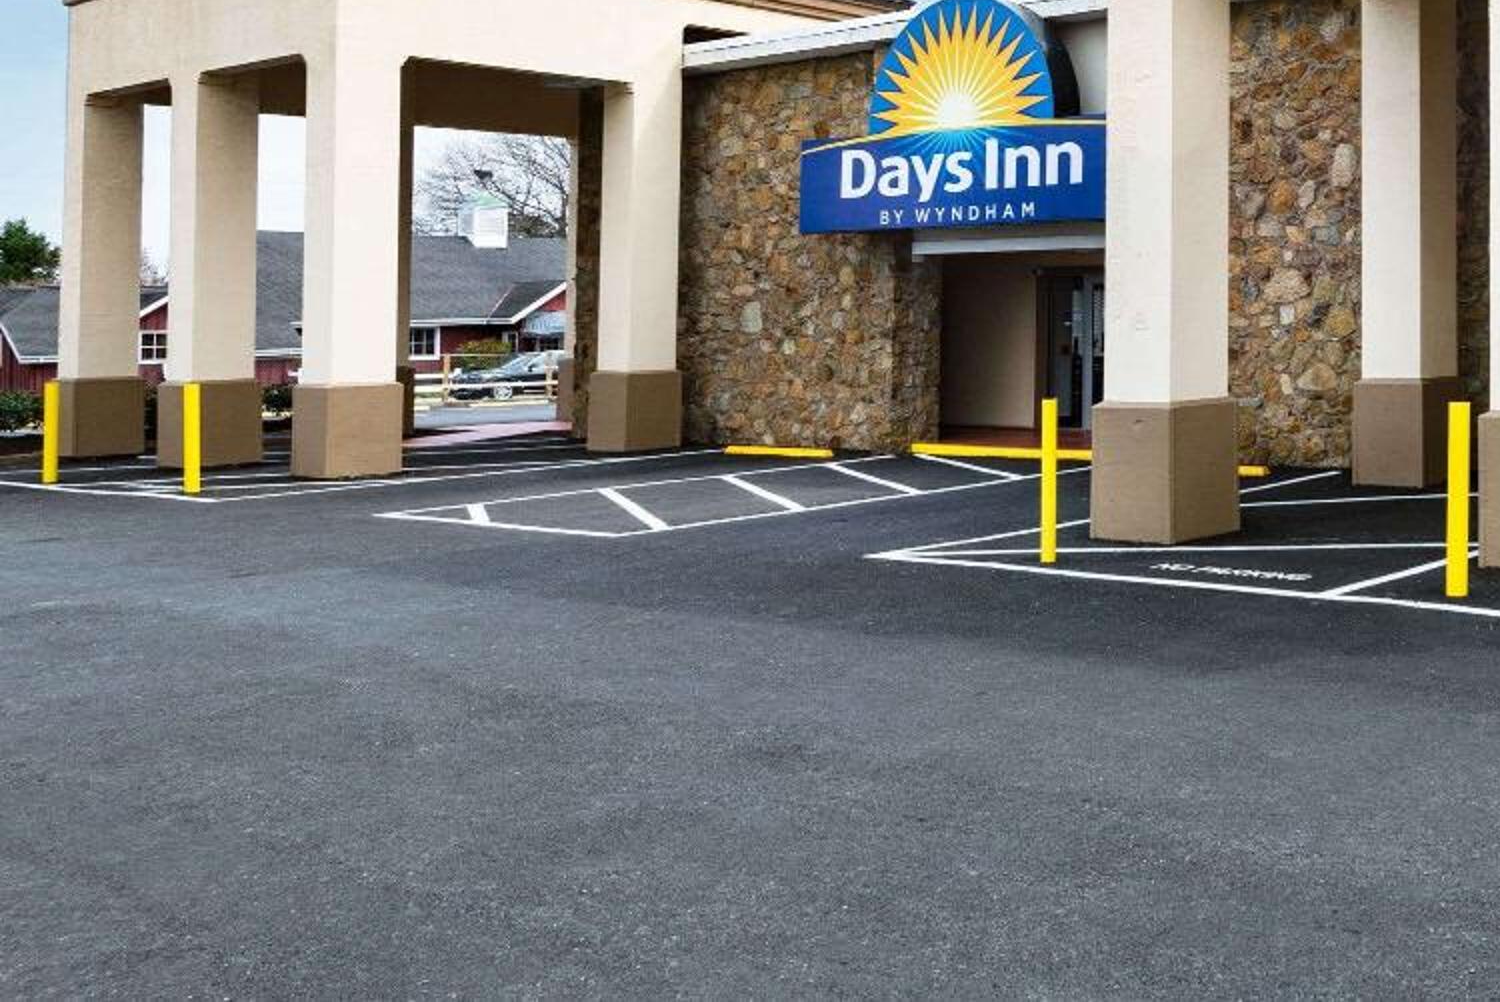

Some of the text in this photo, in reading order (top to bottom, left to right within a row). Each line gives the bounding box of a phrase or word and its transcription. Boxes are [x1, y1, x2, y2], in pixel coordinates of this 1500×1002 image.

[839, 137, 1083, 202] Days Inn
[879, 201, 1035, 225] BY WYNDHAM
[1150, 562, 1312, 581] NO PARKING
